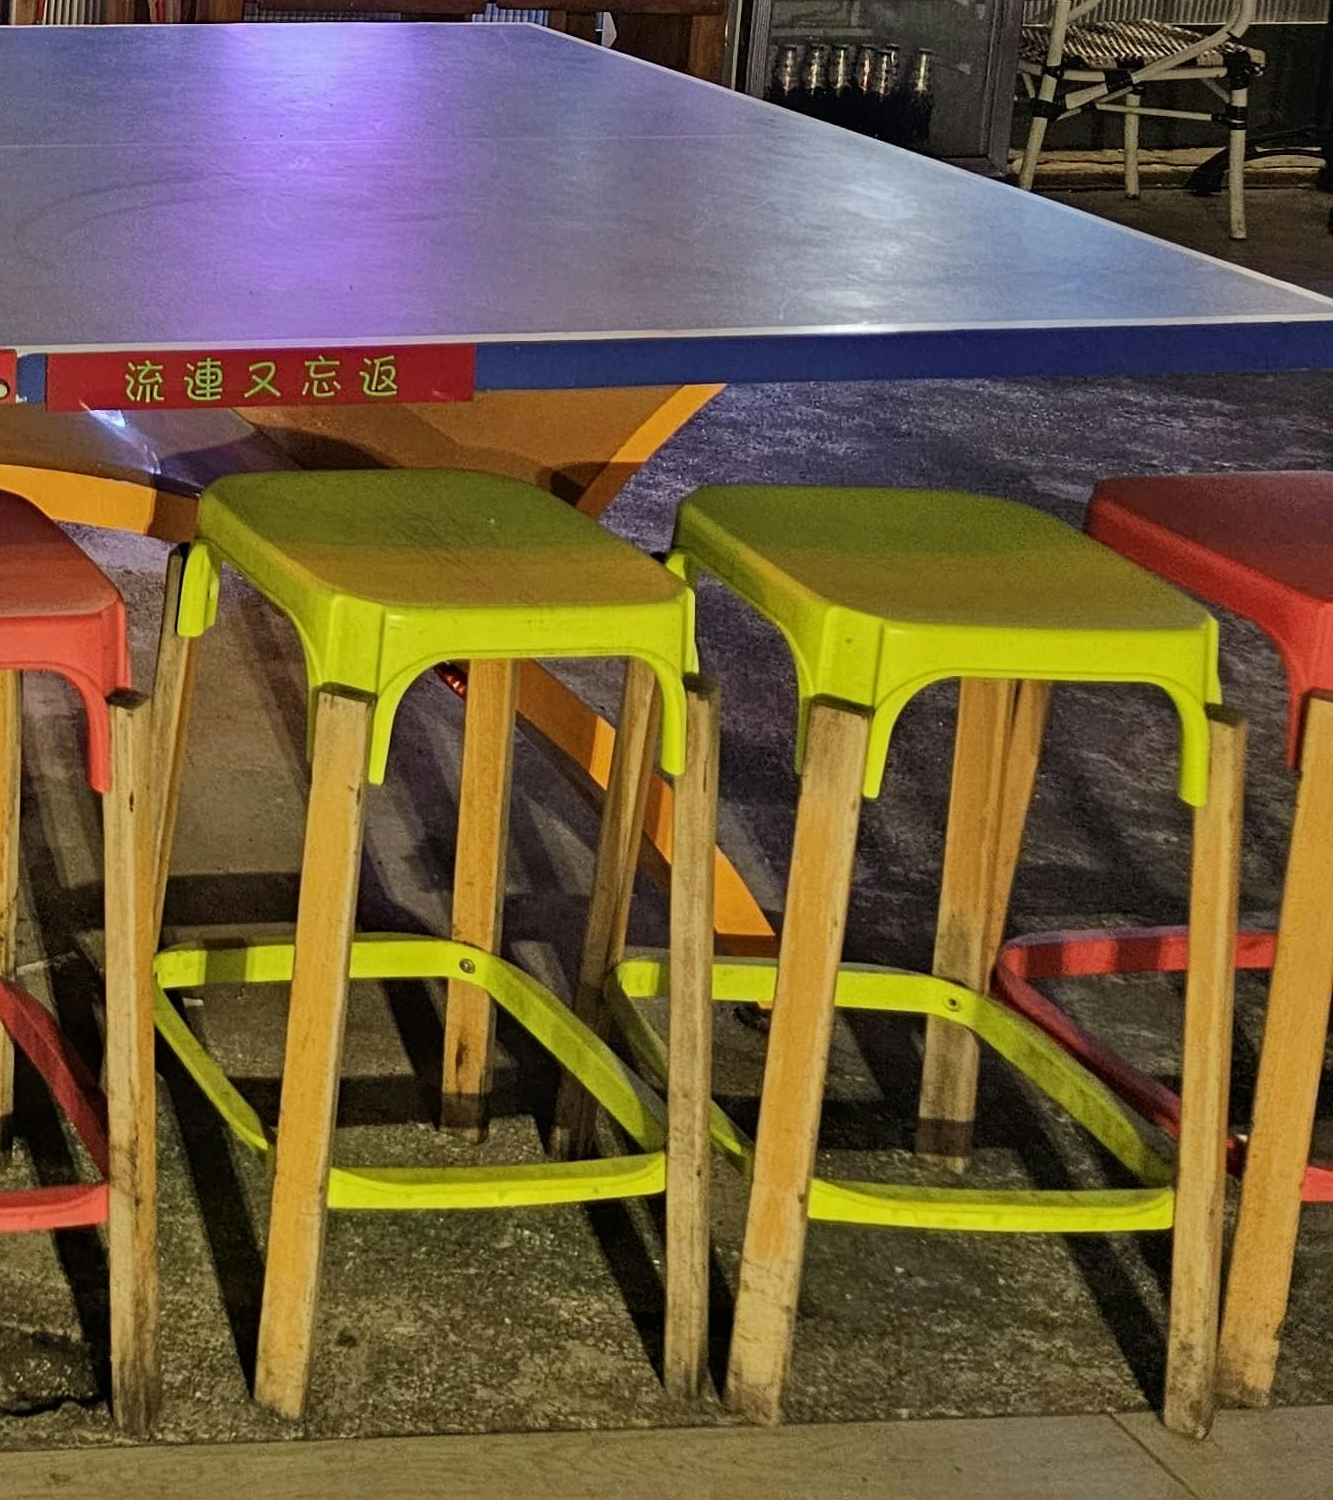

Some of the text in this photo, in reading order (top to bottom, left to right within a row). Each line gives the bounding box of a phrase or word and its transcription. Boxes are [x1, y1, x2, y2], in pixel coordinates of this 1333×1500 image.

[123, 357, 400, 404] 流連又忘返
